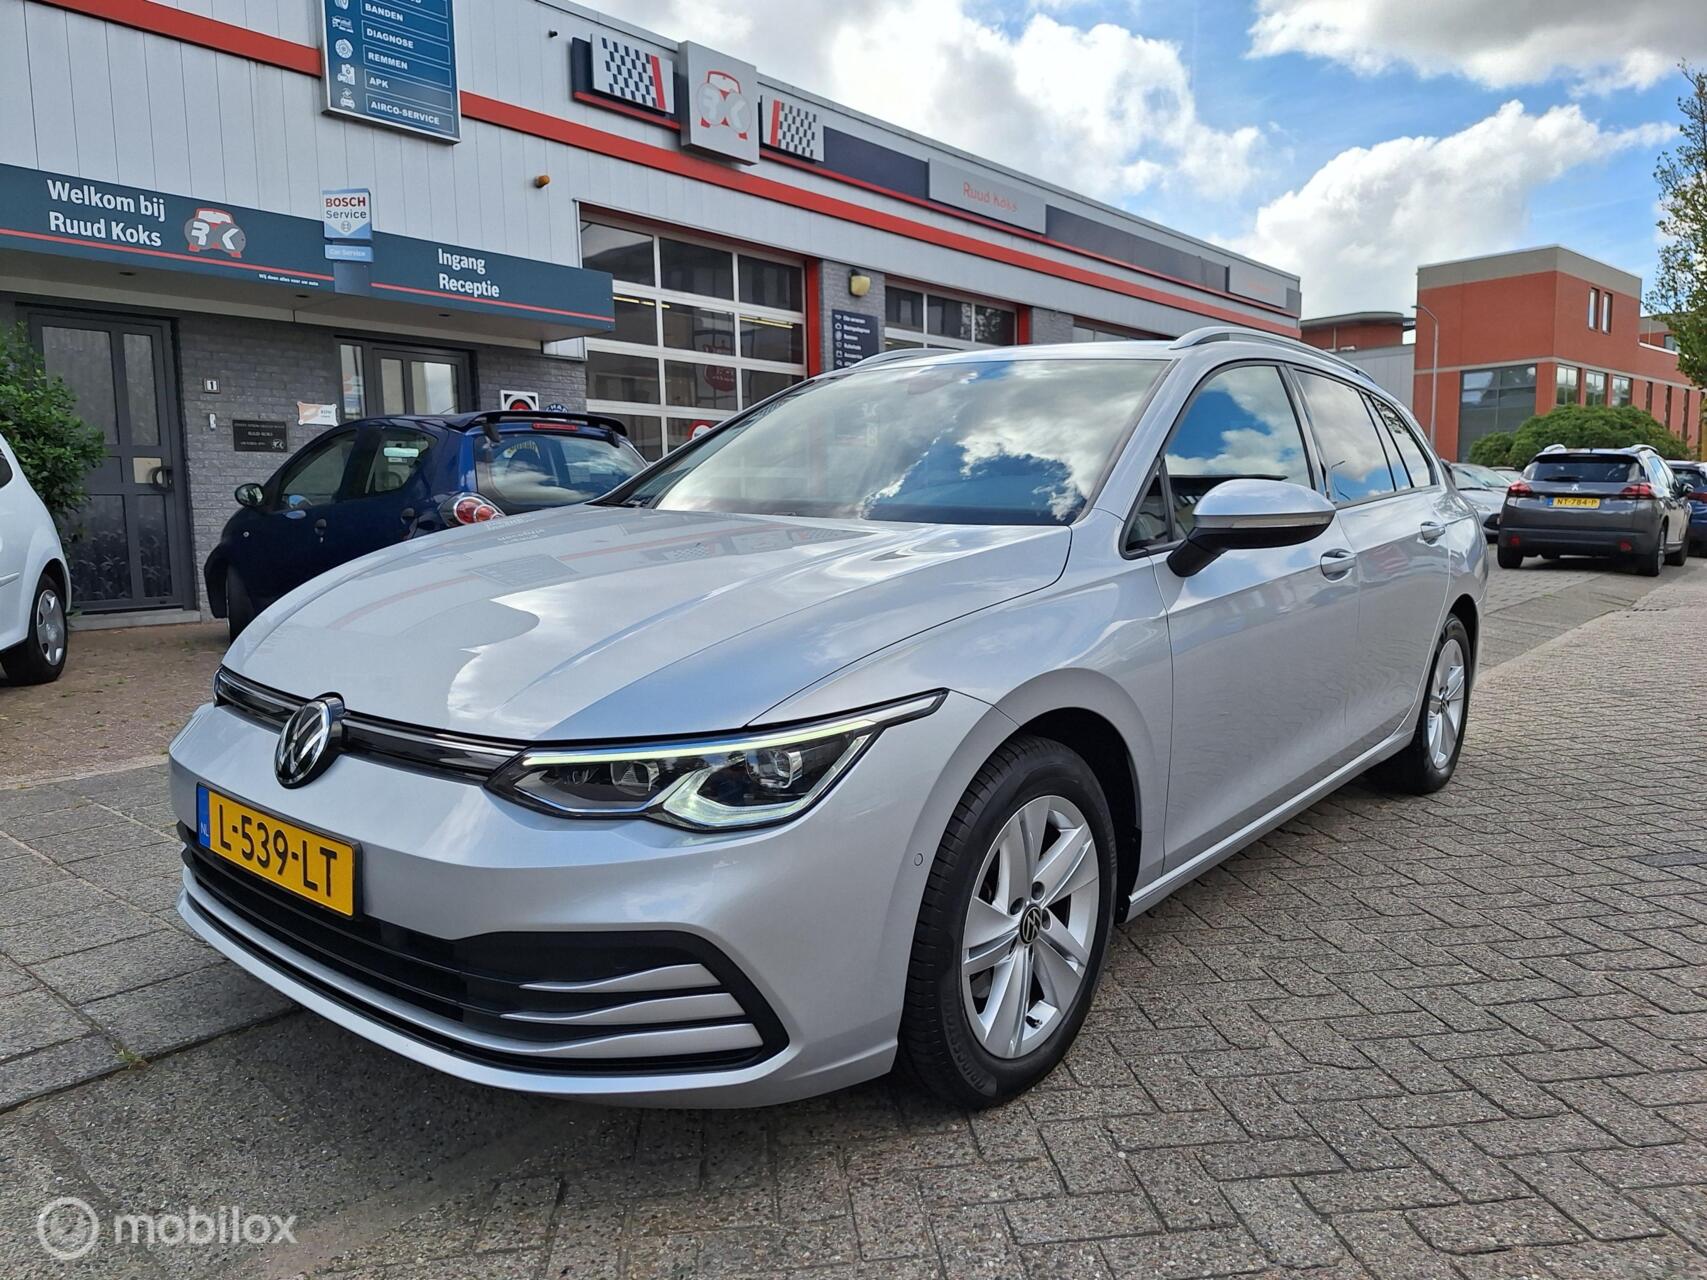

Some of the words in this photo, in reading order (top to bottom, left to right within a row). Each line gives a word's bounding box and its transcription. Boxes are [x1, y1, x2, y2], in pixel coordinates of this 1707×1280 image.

[365, 3, 404, 22] BANDEN
[366, 28, 414, 49] DIAGNOSE
[368, 52, 408, 70] REMMEN
[369, 77, 389, 89] APK
[370, 101, 440, 125] AIRCO-SERVICE
[47, 179, 135, 213] Welkom
[139, 194, 165, 222] bij
[325, 197, 366, 208] BOSCH
[963, 182, 990, 203] Ruud
[326, 208, 367, 219] Service
[49, 211, 106, 239] Ruud
[111, 218, 162, 248] Koks
[438, 248, 486, 275] Ingang
[439, 273, 500, 298] Receptie
[200, 821, 210, 837] NL
[219, 804, 338, 897] L-539-LT
